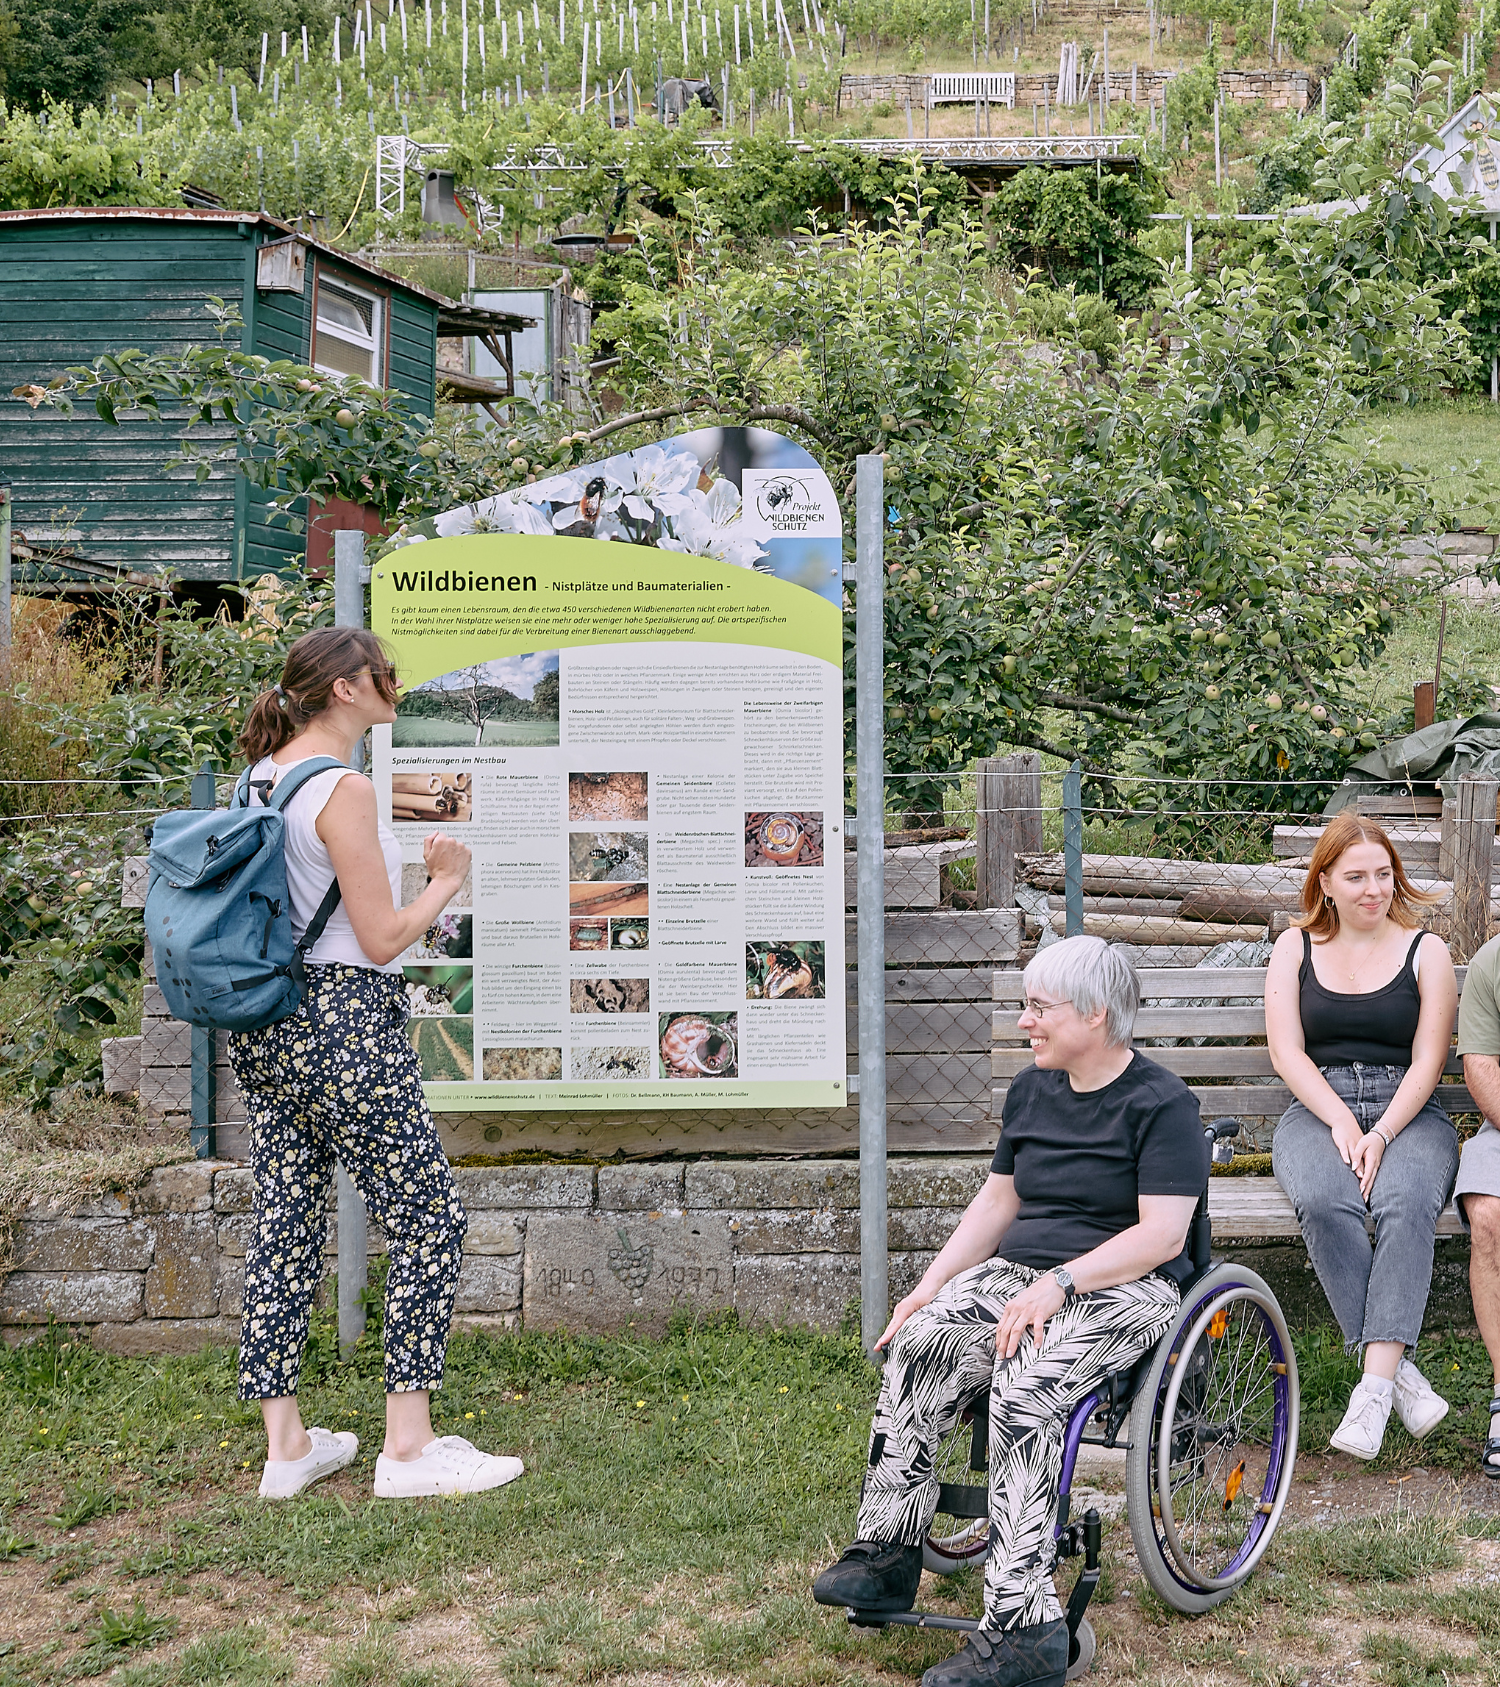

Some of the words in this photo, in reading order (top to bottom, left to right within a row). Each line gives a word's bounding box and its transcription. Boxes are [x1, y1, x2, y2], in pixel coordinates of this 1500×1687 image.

[792, 502, 821, 512] Projekt
[763, 513, 824, 522] WILDBIENEN
[772, 522, 807, 531] SCHUTZ
[392, 570, 536, 591] Wildbienen
[552, 581, 608, 591] Nistplätze
[612, 581, 634, 591] und
[637, 581, 723, 591] Baumaterialien
[391, 606, 400, 614] Es
[401, 606, 416, 616] gibt
[418, 606, 439, 614] kaum
[463, 606, 510, 614] Lebensraum,
[512, 606, 527, 614] den
[528, 605, 540, 614] die
[541, 606, 561, 614] etwa
[562, 605, 577, 613] 450
[578, 605, 632, 613] verschiedenen
[633, 605, 695, 613] Wildbienenarten
[696, 605, 715, 613] nicht
[716, 605, 745, 613] erobert
[746, 604, 771, 613] haben.
[391, 617, 399, 625] In
[400, 617, 414, 625] der
[415, 617, 435, 625] Wahl
[436, 617, 454, 625] ihrer
[455, 617, 493, 625] Nistplätze
[522, 616, 532, 625] sie
[534, 616, 550, 624] eine
[552, 616, 572, 624] mehr
[573, 616, 591, 624] oder
[592, 617, 623, 626] weniger
[624, 616, 643, 624] hohe
[644, 616, 700, 625] Spezialisierung
[701, 615, 716, 625] auf.
[717, 616, 730, 624] Die
[731, 615, 787, 625] artspezifischen
[391, 628, 458, 636] Nistmöglichkeiten
[460, 627, 476, 636] sind
[476, 627, 498, 636] dabei
[499, 627, 511, 637] für
[512, 627, 524, 635] die
[525, 627, 570, 636] Verbreitung
[570, 627, 590, 635] einer
[591, 627, 628, 635] Bienenart
[629, 627, 696, 636] ausschlaggebend.
[392, 756, 460, 766] Spezialisierungen
[461, 756, 472, 764] im
[473, 756, 506, 764] Nestbau
